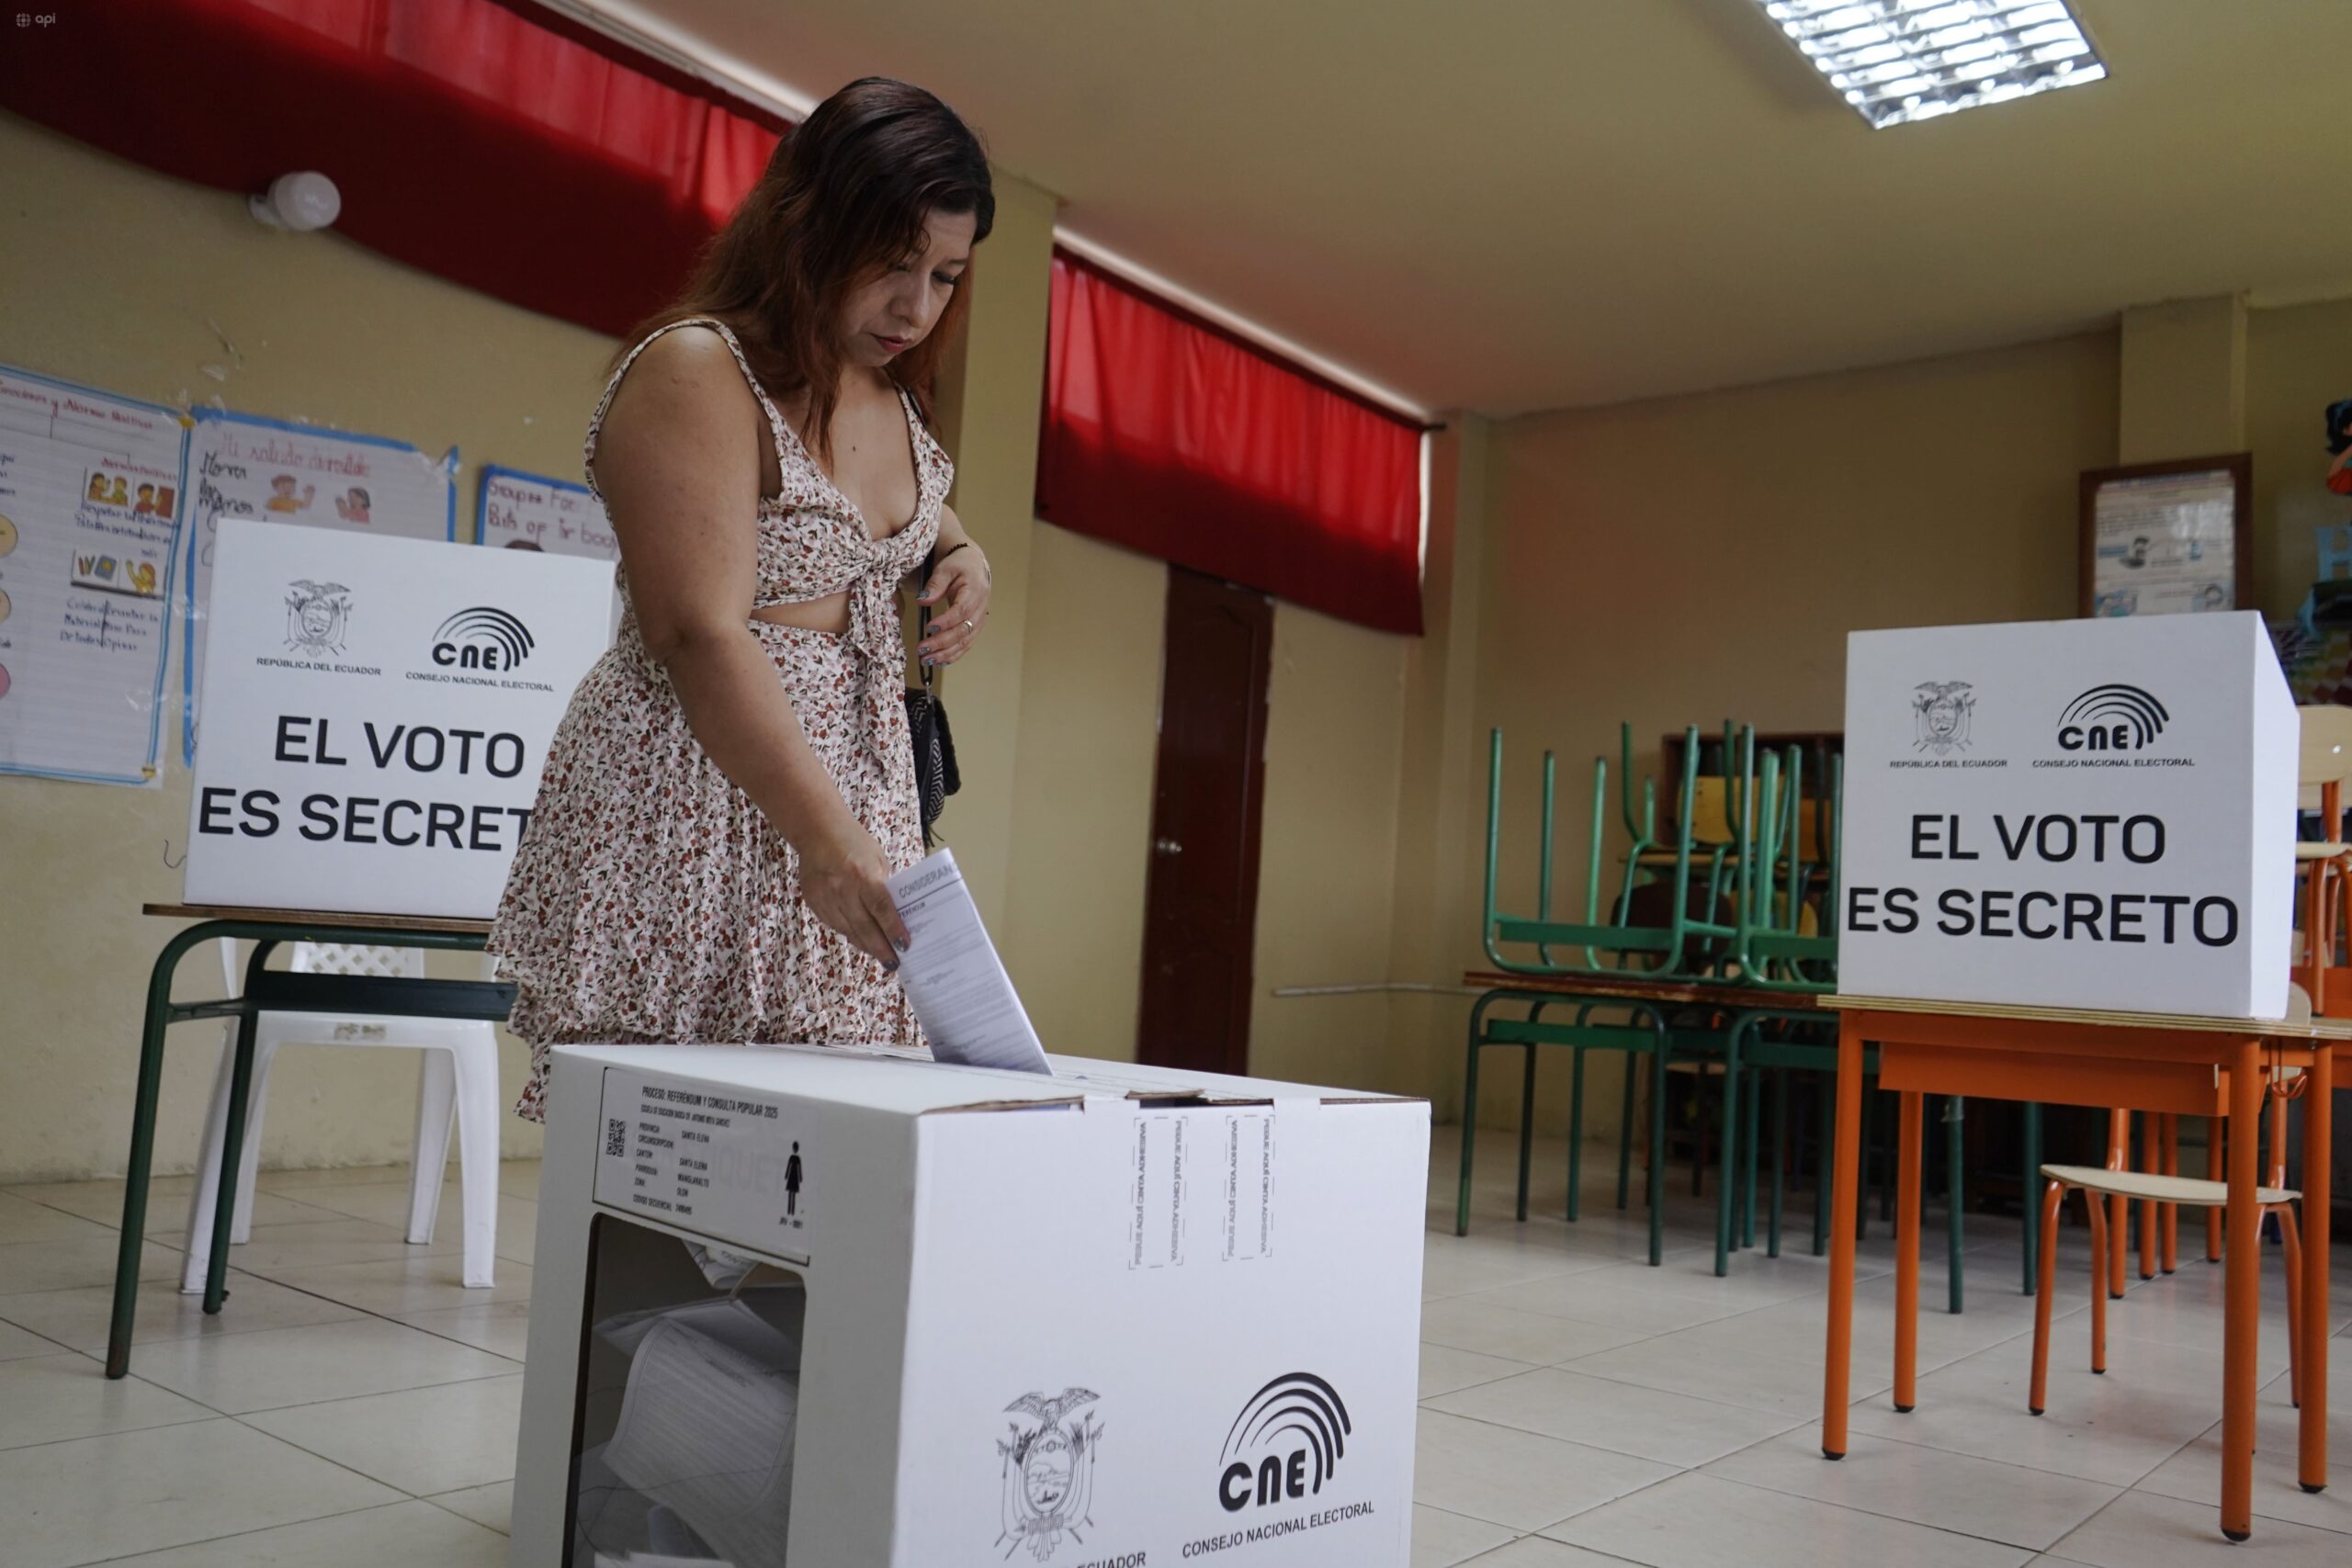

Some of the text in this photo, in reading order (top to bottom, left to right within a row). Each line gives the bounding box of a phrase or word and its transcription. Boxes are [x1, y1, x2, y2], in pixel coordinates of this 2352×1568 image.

[256, 657, 381, 676] REPÚBLICA DEL ECUADOR
[432, 642, 498, 671] CNE
[405, 671, 554, 693] CONSEJO NACIONAL ELECTORAL
[275, 715, 525, 779] EL VOTO
[2058, 724, 2128, 750] CNE
[1942, 760, 1960, 768] DEL
[1962, 760, 2007, 768] ECUADOR
[2032, 758, 2195, 768] CONSEJO NACIONAL ELECTORAL
[198, 786, 534, 852] ES SECRET
[1911, 814, 2165, 863] EL VOTO
[1848, 886, 2238, 947] ES SECRETO
[642, 1086, 666, 1100] PROCESO:
[707, 1096, 735, 1111] CONSULTA
[737, 1101, 763, 1117] POPULAR
[763, 1105, 778, 1119] 2025
[682, 1130, 710, 1143] SANTA ELENA
[1138, 1122, 1147, 1172] ADHESIVA
[680, 1157, 707, 1171] SANTA ELENA
[1172, 1180, 1181, 1212] CINTA
[1170, 1212, 1179, 1262] ADHESIVA
[1218, 1449, 1306, 1512] CNE
[1182, 1500, 1374, 1559] CONSEJO NACIONAL ELECTORAL
